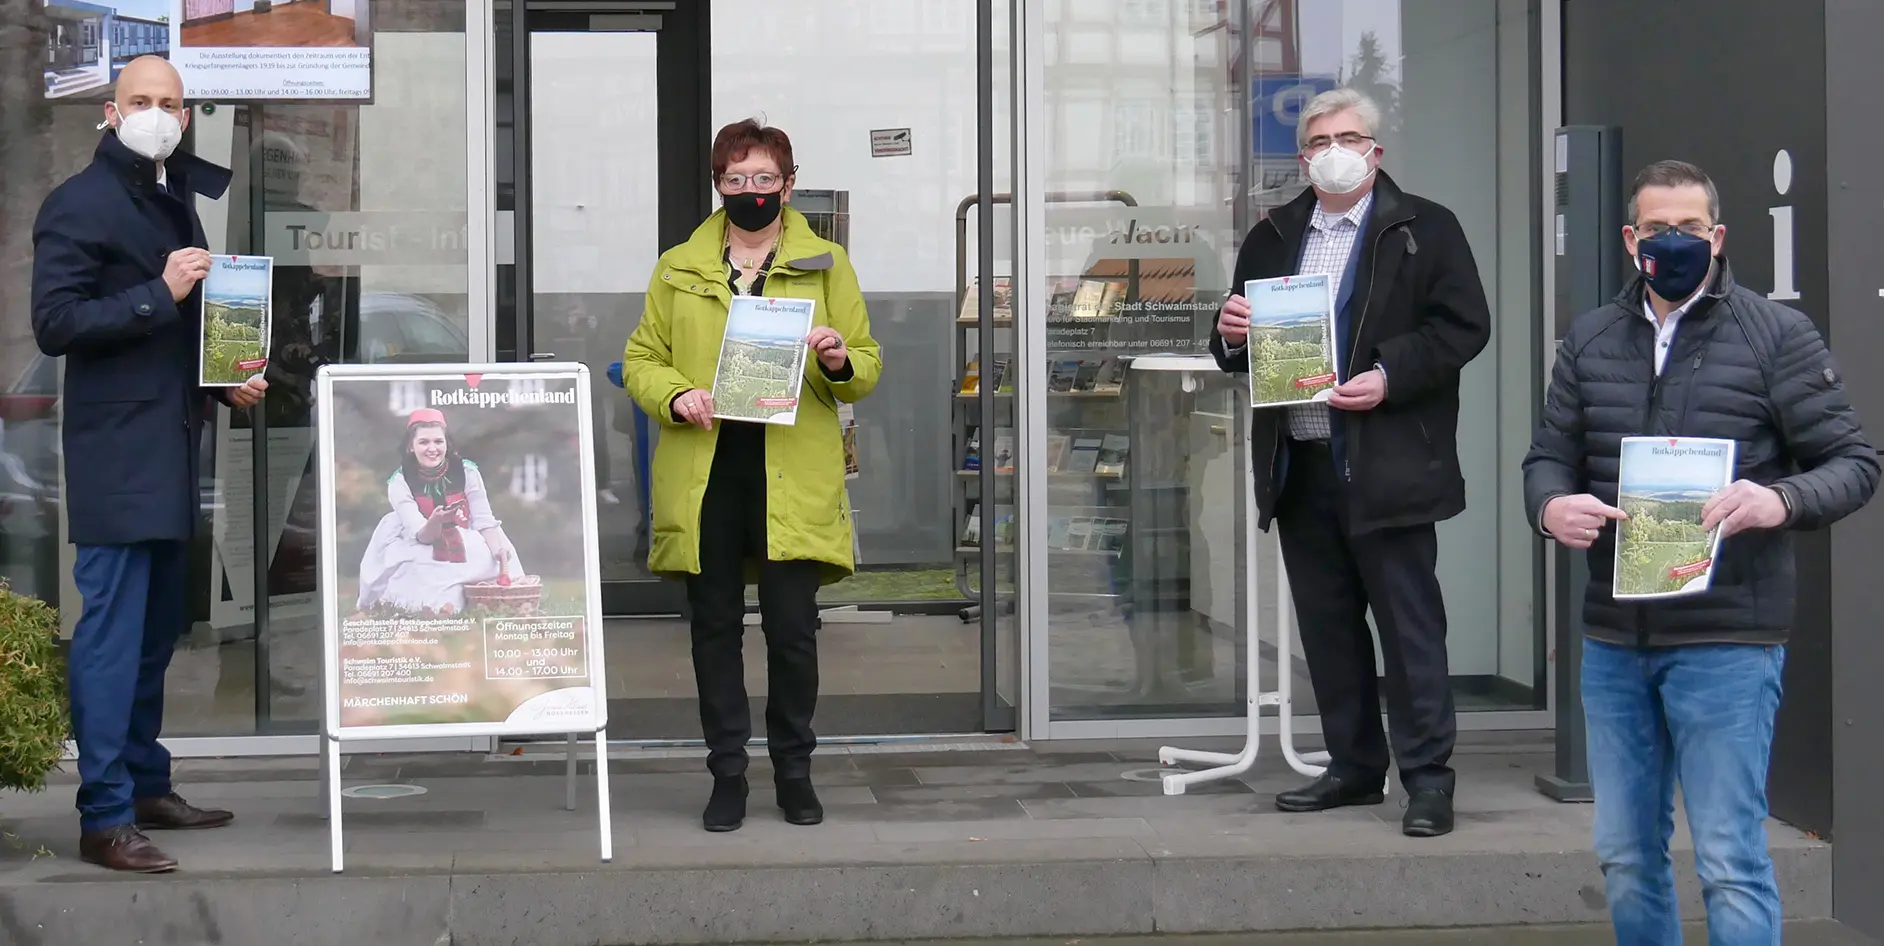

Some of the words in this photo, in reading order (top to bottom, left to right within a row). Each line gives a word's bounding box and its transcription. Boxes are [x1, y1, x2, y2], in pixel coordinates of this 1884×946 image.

[1767, 149, 1800, 300] i
[1106, 219, 1200, 245] Wach
[286, 224, 399, 251] Tourist
[1114, 301, 1142, 311] Stadt
[1145, 301, 1219, 311] Schwalmstadt
[1134, 315, 1149, 323] und
[1151, 315, 1191, 323] Tourismus
[1046, 340, 1086, 348] elefonisch
[1087, 340, 1126, 348] erreichbar
[1150, 339, 1174, 347] 06691
[1176, 339, 1191, 347] 207
[430, 388, 575, 408] Rotkäppchenland
[343, 619, 398, 627] Geschäftsstelle
[399, 618, 463, 626] Rotkäppchenland
[496, 621, 573, 632] Öffnungszeiten
[343, 626, 387, 634] Paradeplatz
[420, 624, 470, 632] Schwalmstadt
[380, 631, 394, 639] 207
[495, 632, 529, 641] Montag
[530, 631, 543, 639] bis
[544, 631, 575, 640] Freitag
[343, 638, 439, 647] info@rotkaeppchenland.de
[531, 648, 558, 657] 13.00
[560, 647, 578, 656] Uhr
[343, 657, 376, 665] Schwalm
[526, 658, 546, 667] und
[343, 664, 387, 672] Paradeplatz
[421, 662, 471, 670] Schwalmstadt
[494, 667, 523, 676] 14.00
[532, 666, 558, 675] 17.00
[560, 665, 578, 674] Uhr
[357, 670, 380, 678] 06691
[395, 669, 411, 677] 400
[343, 676, 434, 685] info@schwalmtouristik.de
[343, 696, 427, 708] MÄRCHENHAFT
[429, 693, 468, 705] SCHÖN
